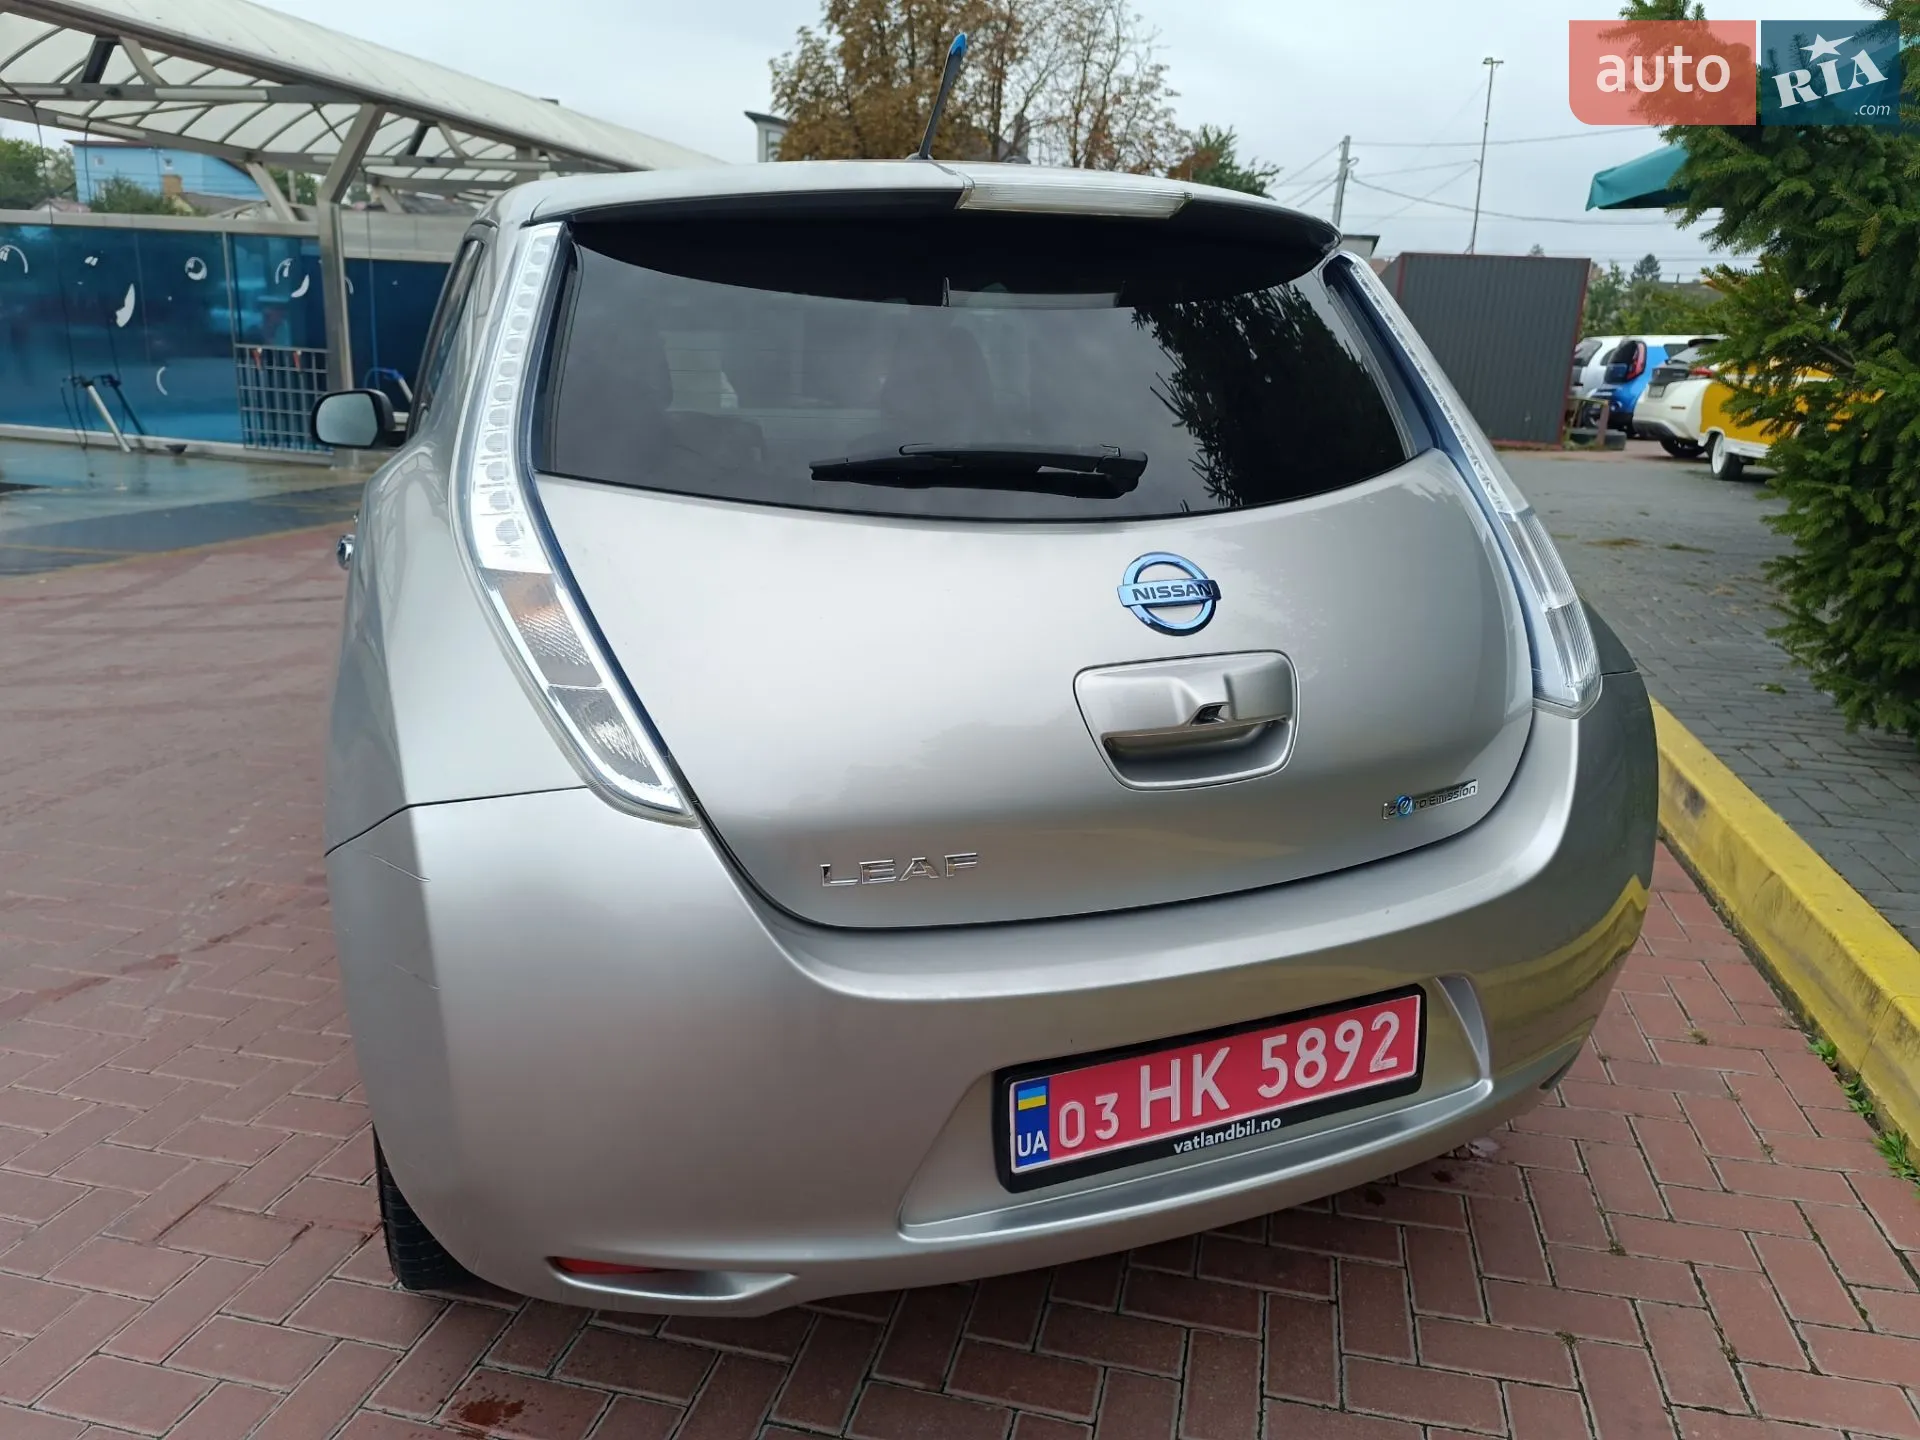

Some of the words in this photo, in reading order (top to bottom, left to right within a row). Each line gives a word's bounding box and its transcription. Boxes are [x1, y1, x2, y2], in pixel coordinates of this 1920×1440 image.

[1131, 583, 1214, 601] NISSAN
[820, 852, 977, 887] LEAF
[1058, 1093, 1120, 1149] 03
[1140, 1046, 1231, 1129] HK
[1257, 1011, 1400, 1099] 5892
[1017, 1129, 1048, 1157] UA
[1173, 1115, 1282, 1154] vatlandbil.no
